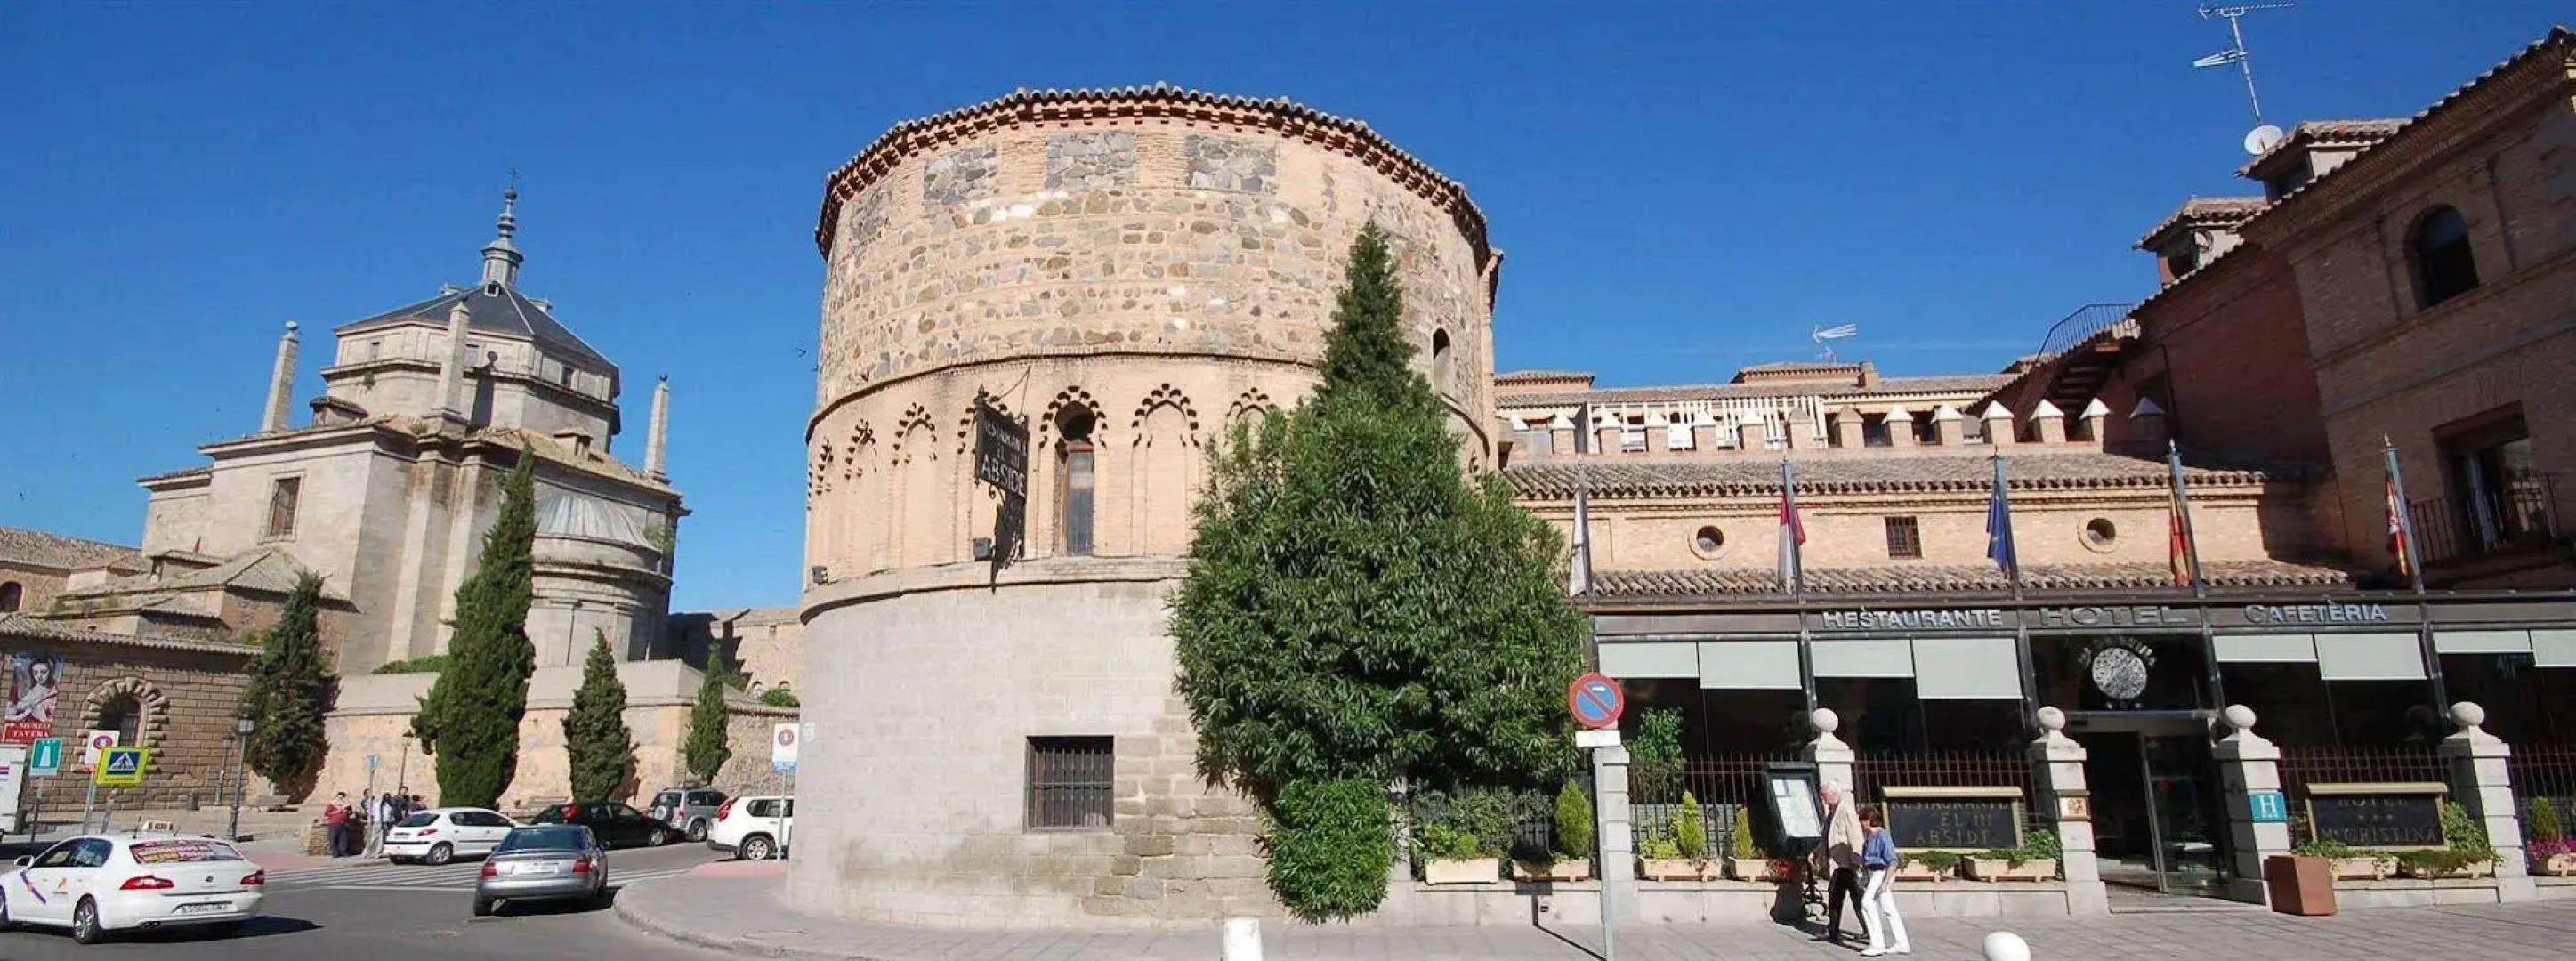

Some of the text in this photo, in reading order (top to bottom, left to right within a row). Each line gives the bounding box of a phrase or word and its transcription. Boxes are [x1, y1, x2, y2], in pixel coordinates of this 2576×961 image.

[981, 453, 1025, 497] ABSIDE
[1822, 610, 2003, 628] RESTAURANTE
[2040, 606, 2187, 626] HOTEL
[2344, 826, 2437, 843] CRISTINA
